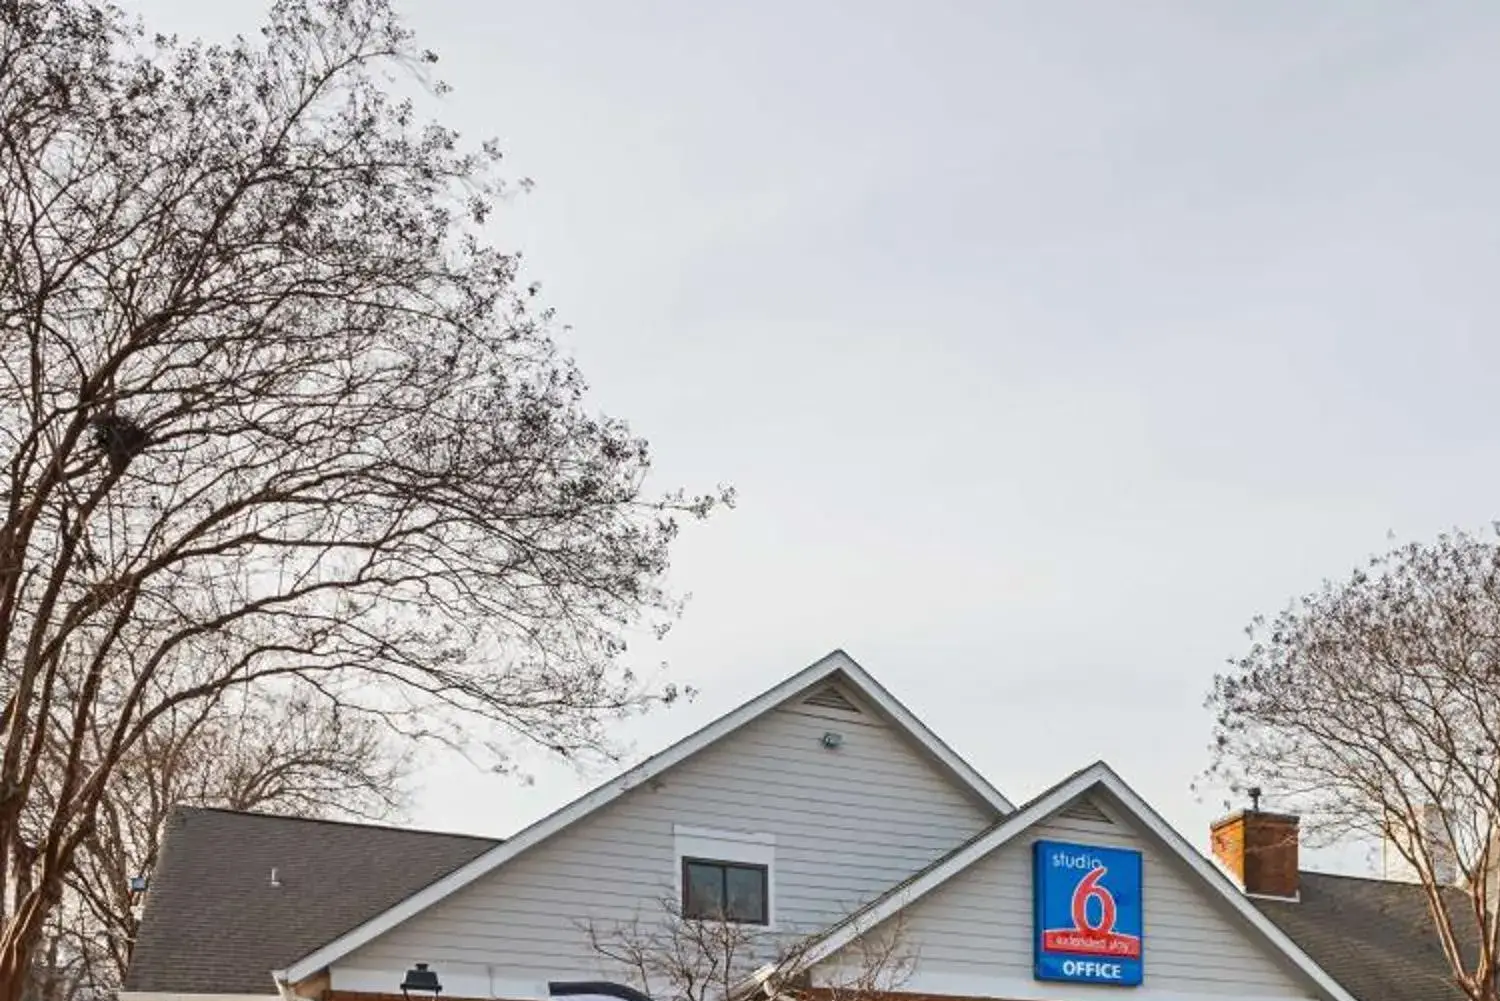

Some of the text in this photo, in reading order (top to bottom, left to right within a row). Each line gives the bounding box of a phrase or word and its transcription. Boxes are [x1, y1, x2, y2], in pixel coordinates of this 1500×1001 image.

[1052, 851, 1102, 869] studio
[1071, 866, 1117, 932] 6
[1062, 960, 1122, 979] OFFICE
